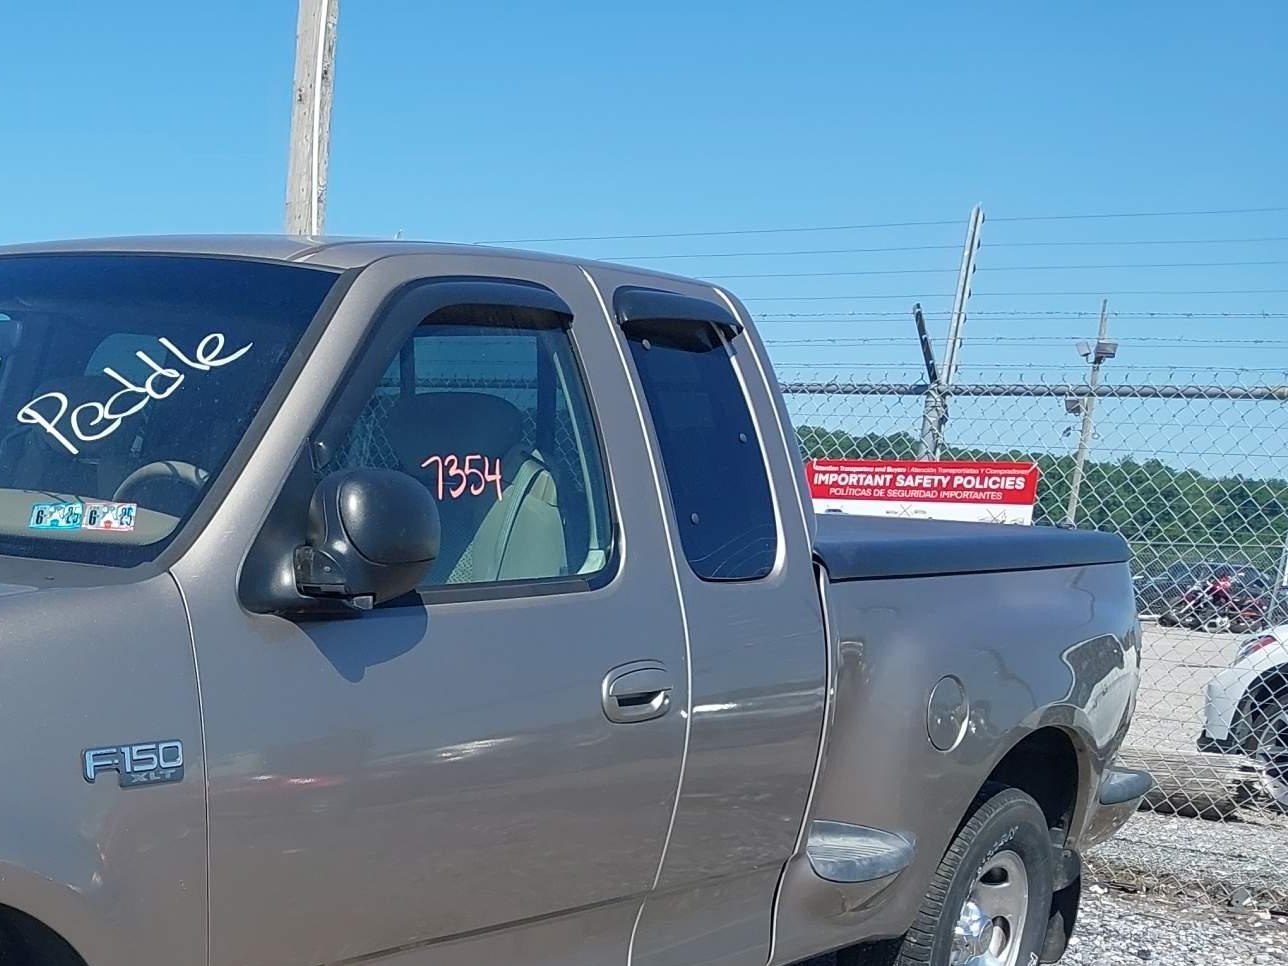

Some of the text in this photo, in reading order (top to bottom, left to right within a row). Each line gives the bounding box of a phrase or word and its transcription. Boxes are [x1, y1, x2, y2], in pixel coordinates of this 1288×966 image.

[421, 454, 503, 501] 7354
[814, 473, 1025, 490] IMPORTANT SAFETY POLICIES
[829, 487, 1003, 500] POLÍTICAS DE SEGURIDAD IMPORTANTES
